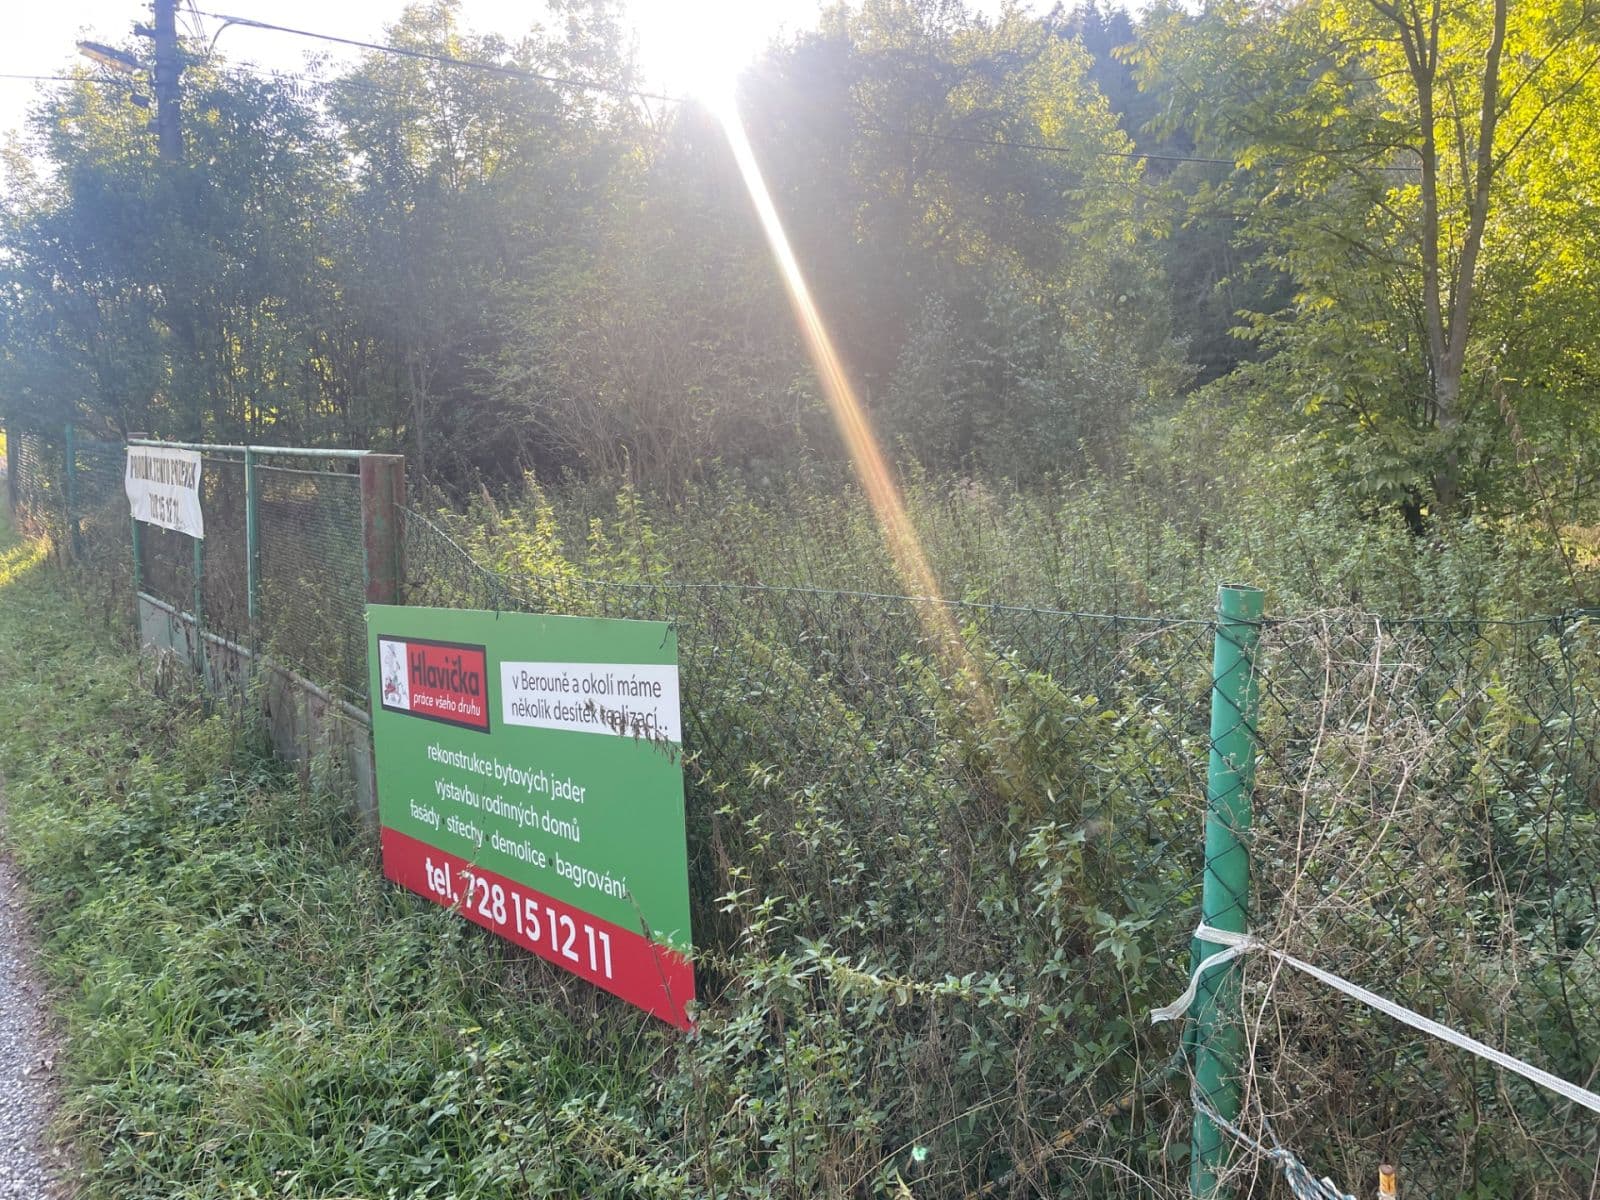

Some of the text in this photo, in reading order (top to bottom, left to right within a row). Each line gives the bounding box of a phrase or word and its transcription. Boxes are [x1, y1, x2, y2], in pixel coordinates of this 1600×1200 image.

[410, 650, 480, 697] Hlavička
[512, 670, 662, 699] v Berouně a okolí máme
[413, 692, 481, 716] práce všeho druhu
[511, 698, 551, 721] několik
[553, 700, 598, 724] desítek
[427, 742, 586, 804] rekonstrukce bytových jader
[435, 777, 581, 843] výstavbu rodinných domů
[410, 799, 627, 900] fasády střechy demolice bagrování
[461, 872, 507, 925] 728
[511, 892, 541, 942] 15
[546, 907, 579, 963] 12
[584, 924, 613, 980] 11
